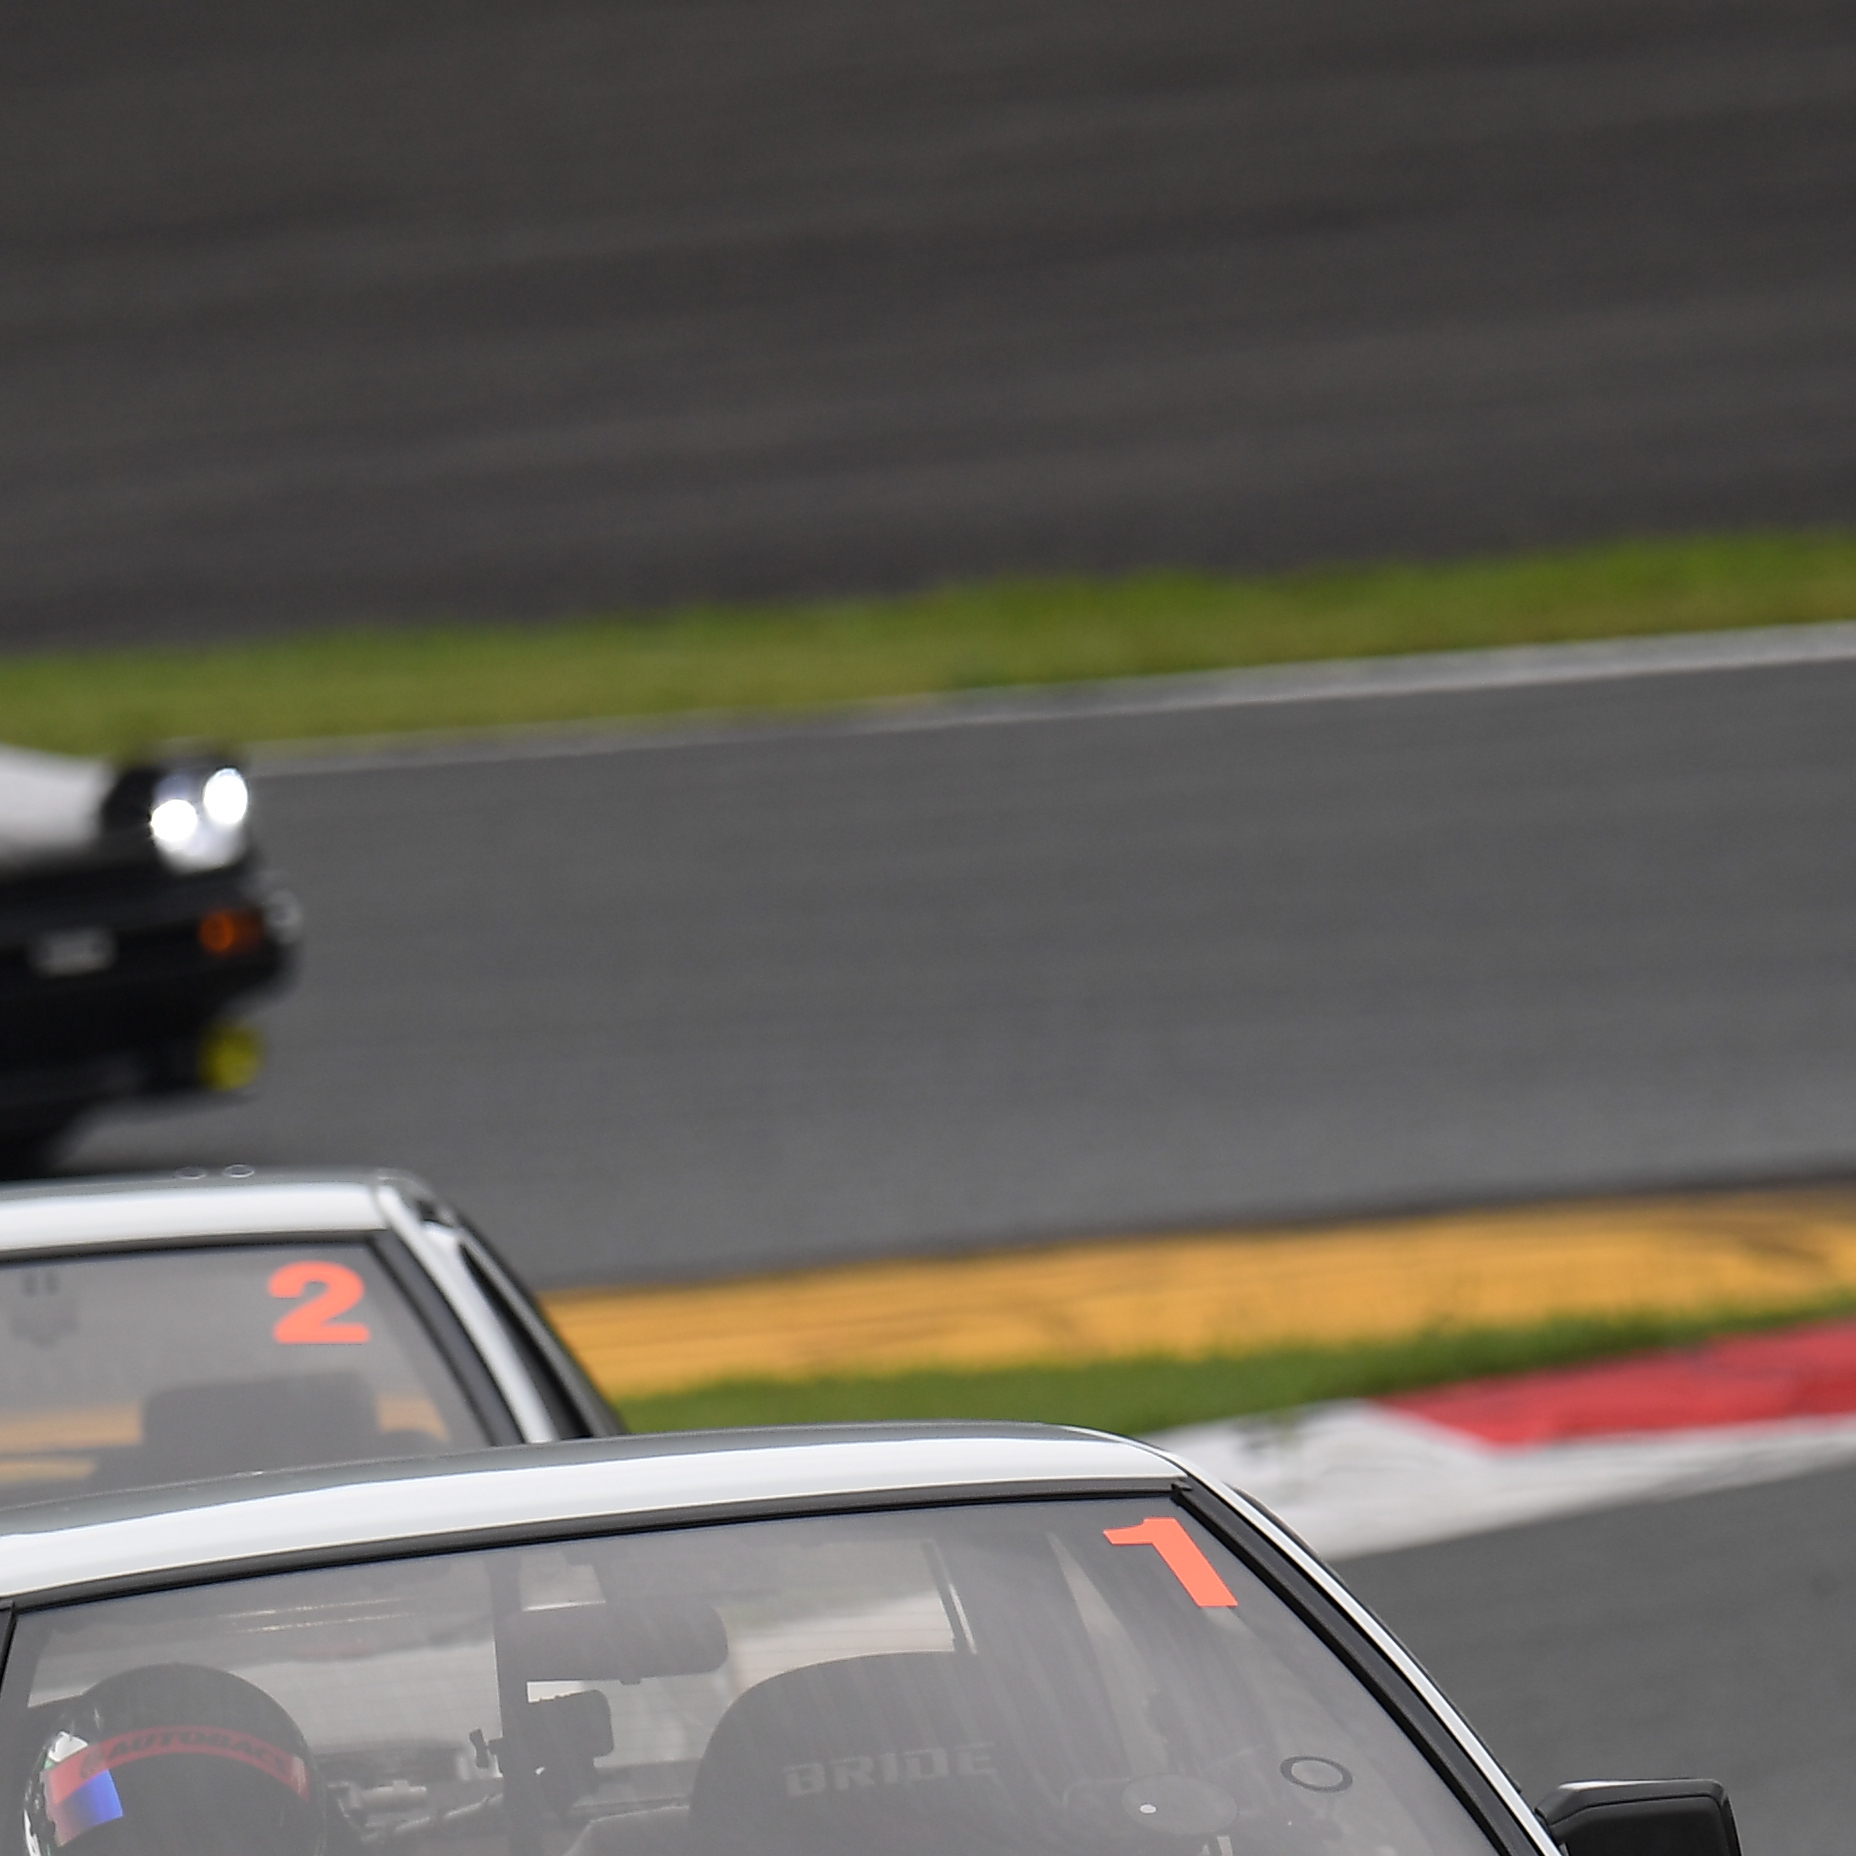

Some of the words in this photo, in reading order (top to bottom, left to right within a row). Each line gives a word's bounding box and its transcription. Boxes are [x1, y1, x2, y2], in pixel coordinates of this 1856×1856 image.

[267, 1259, 371, 1344] 2
[1102, 1516, 1238, 1608] 1
[781, 1741, 999, 1798] BRIDE
